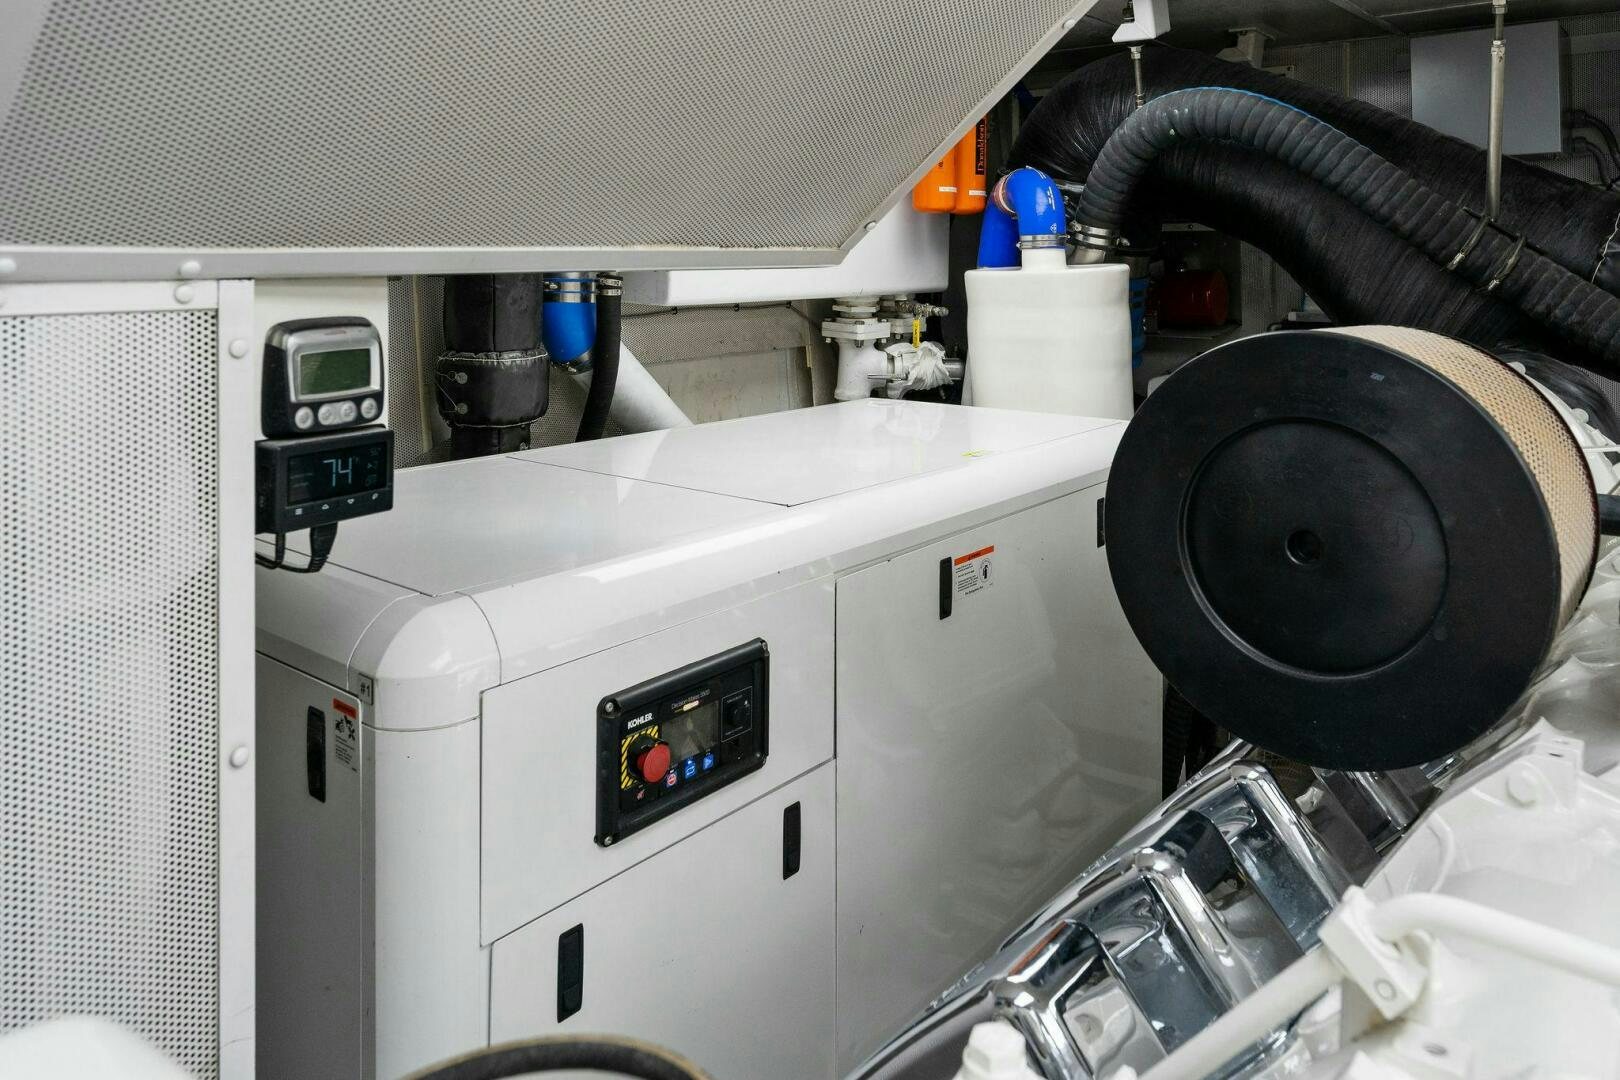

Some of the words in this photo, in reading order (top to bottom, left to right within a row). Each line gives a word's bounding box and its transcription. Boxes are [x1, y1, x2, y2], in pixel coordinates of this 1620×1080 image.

[977, 124, 985, 171] Donaldson
[323, 457, 352, 487] 74
[360, 682, 370, 697] #1
[627, 712, 653, 730] KOHLER
